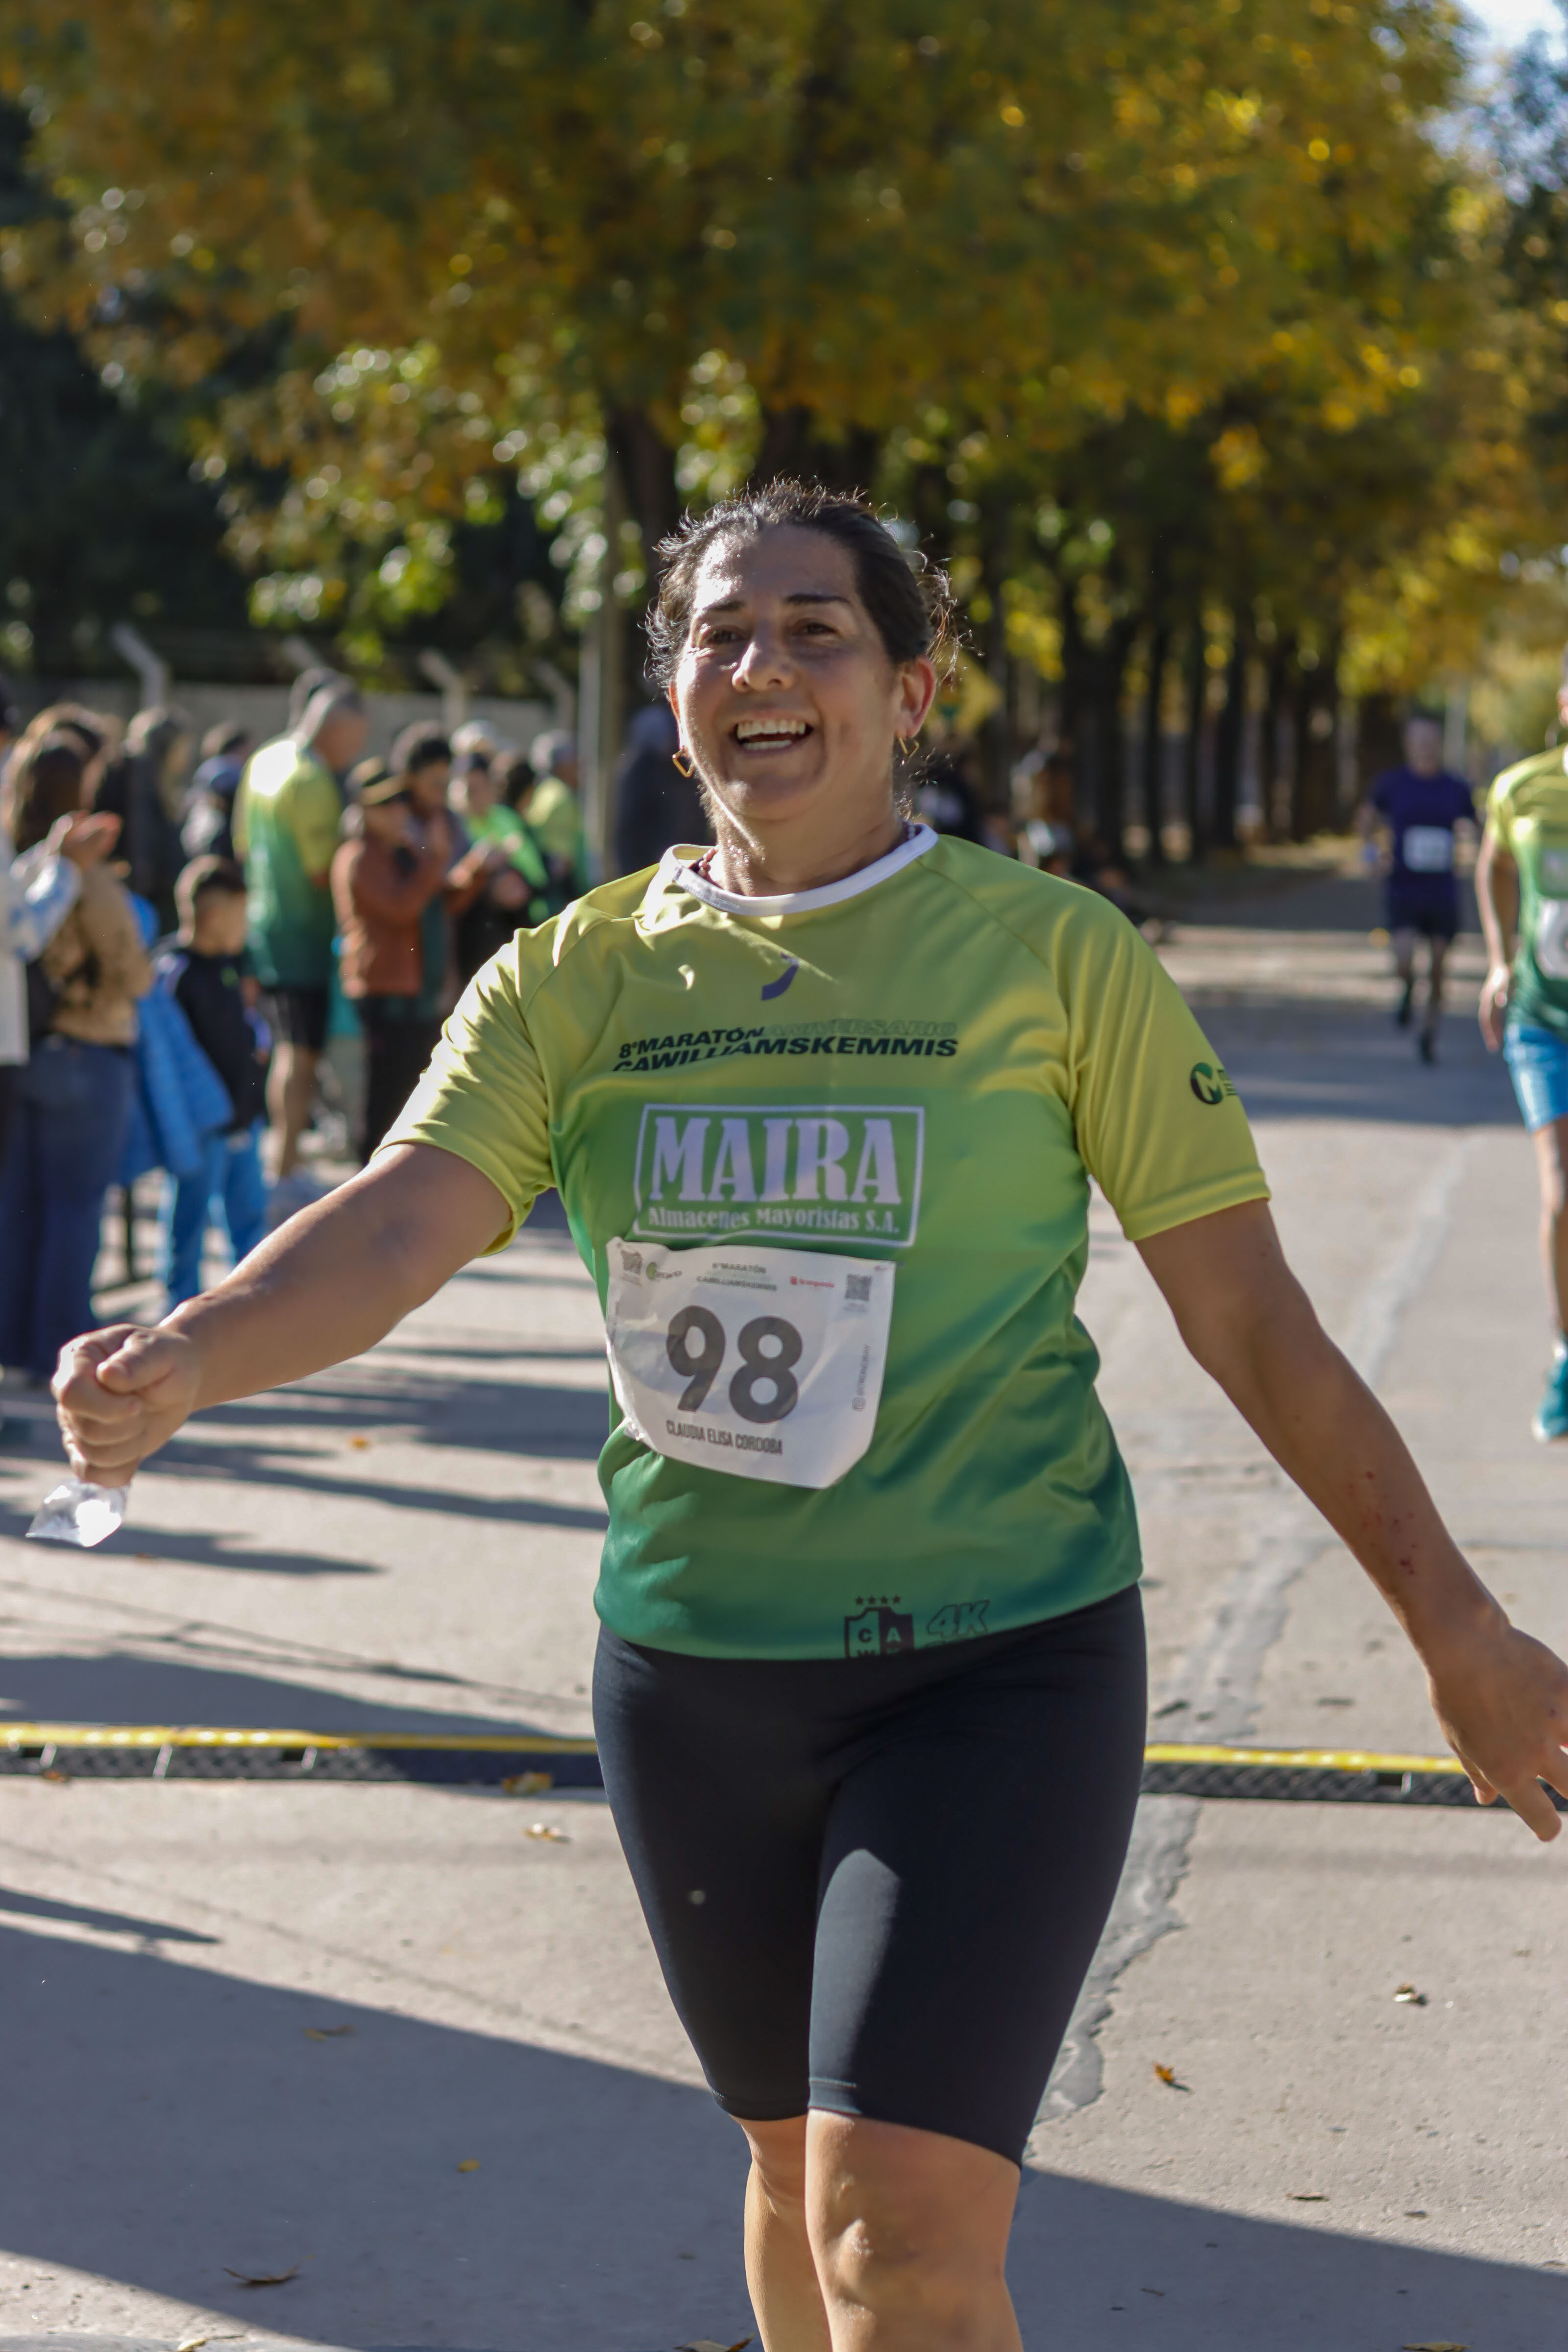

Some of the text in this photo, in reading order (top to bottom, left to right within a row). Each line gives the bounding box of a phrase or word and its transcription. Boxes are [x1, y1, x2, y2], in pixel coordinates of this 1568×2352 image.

[649, 1116, 902, 1204] MAIRA
[648, 1206, 900, 1233] Almacenes Mayoristas S.A.
[665, 1304, 804, 1424] 98
[666, 1419, 783, 1456] CLAUDIA ELISA CORDOBA
[926, 1599, 990, 1639] 4K
